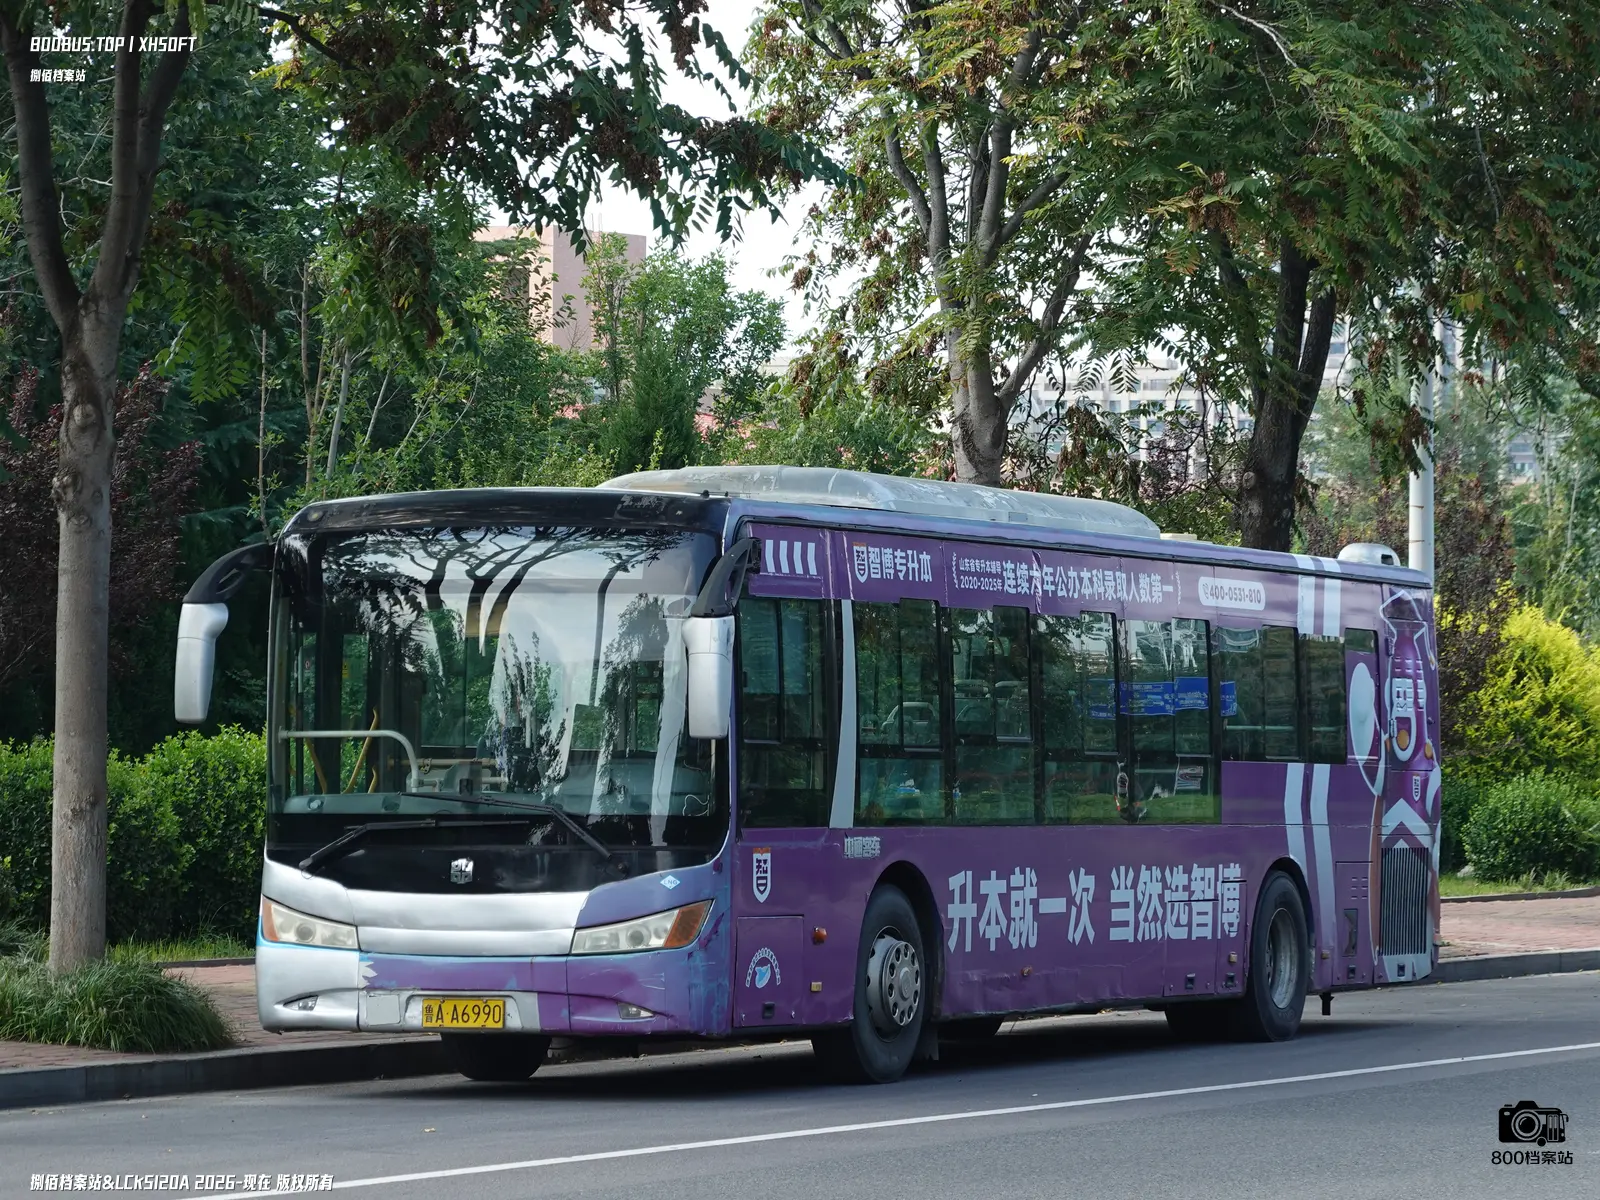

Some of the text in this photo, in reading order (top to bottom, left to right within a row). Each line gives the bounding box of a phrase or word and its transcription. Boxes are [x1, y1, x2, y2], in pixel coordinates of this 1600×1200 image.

[868, 546, 932, 583] 智博专升本
[1003, 560, 1174, 604] 连续六年公办本科录取人数第一
[1210, 584, 1262, 604] 400-0531-810
[947, 863, 1242, 953] 升本就一次 当然选智博
